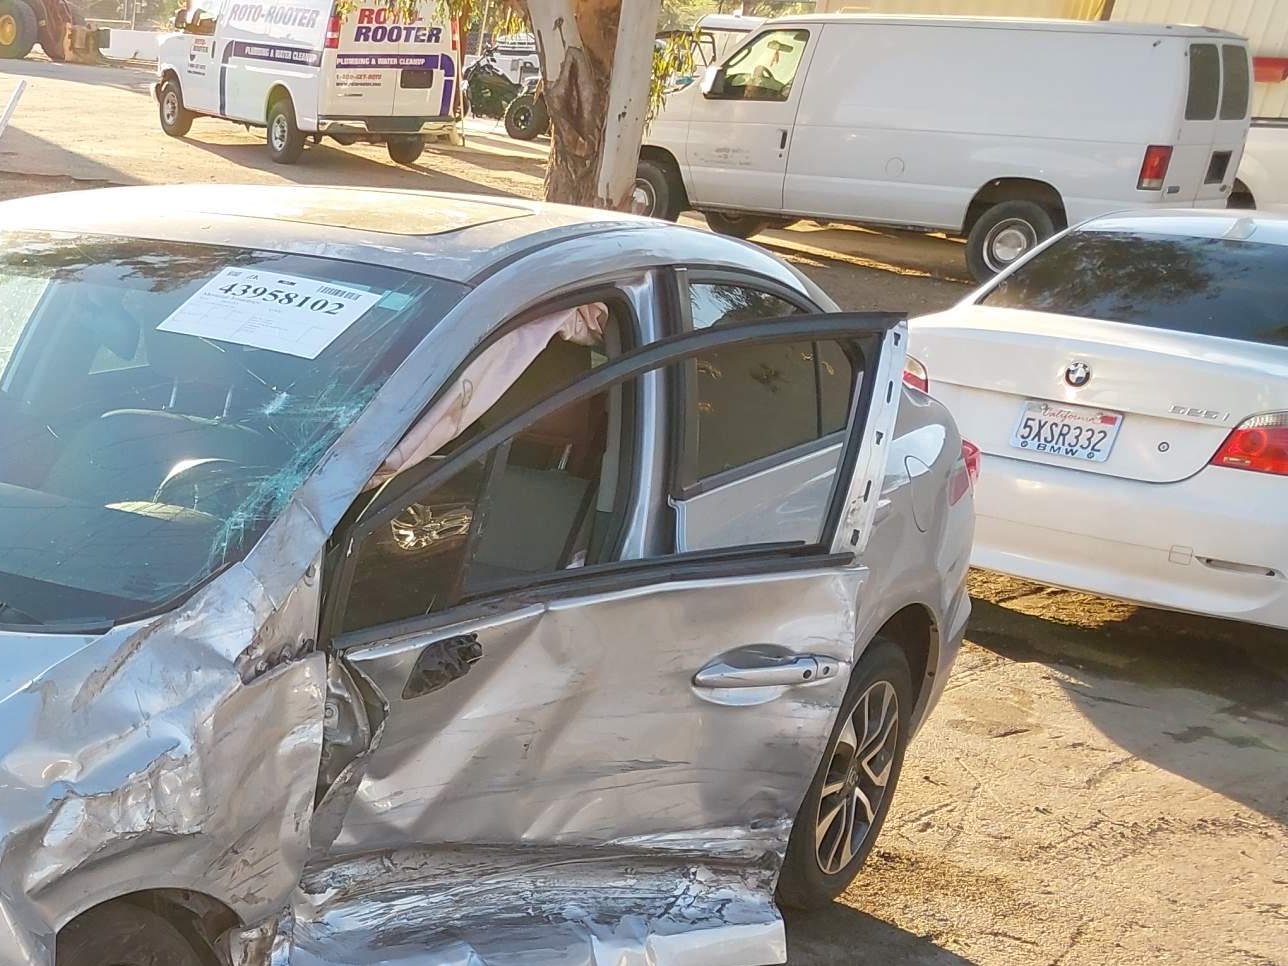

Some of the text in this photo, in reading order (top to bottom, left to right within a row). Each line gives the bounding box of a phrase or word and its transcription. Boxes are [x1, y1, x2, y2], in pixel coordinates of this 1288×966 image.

[229, 4, 320, 29] ROTO-ROOTER
[354, 26, 442, 43] ROOTER
[399, 58, 426, 66] CLEANUP
[219, 282, 345, 315] 43958102
[1041, 405, 1102, 425] California
[1020, 417, 1108, 453] 5XSR332
[1036, 442, 1079, 457] BMW
